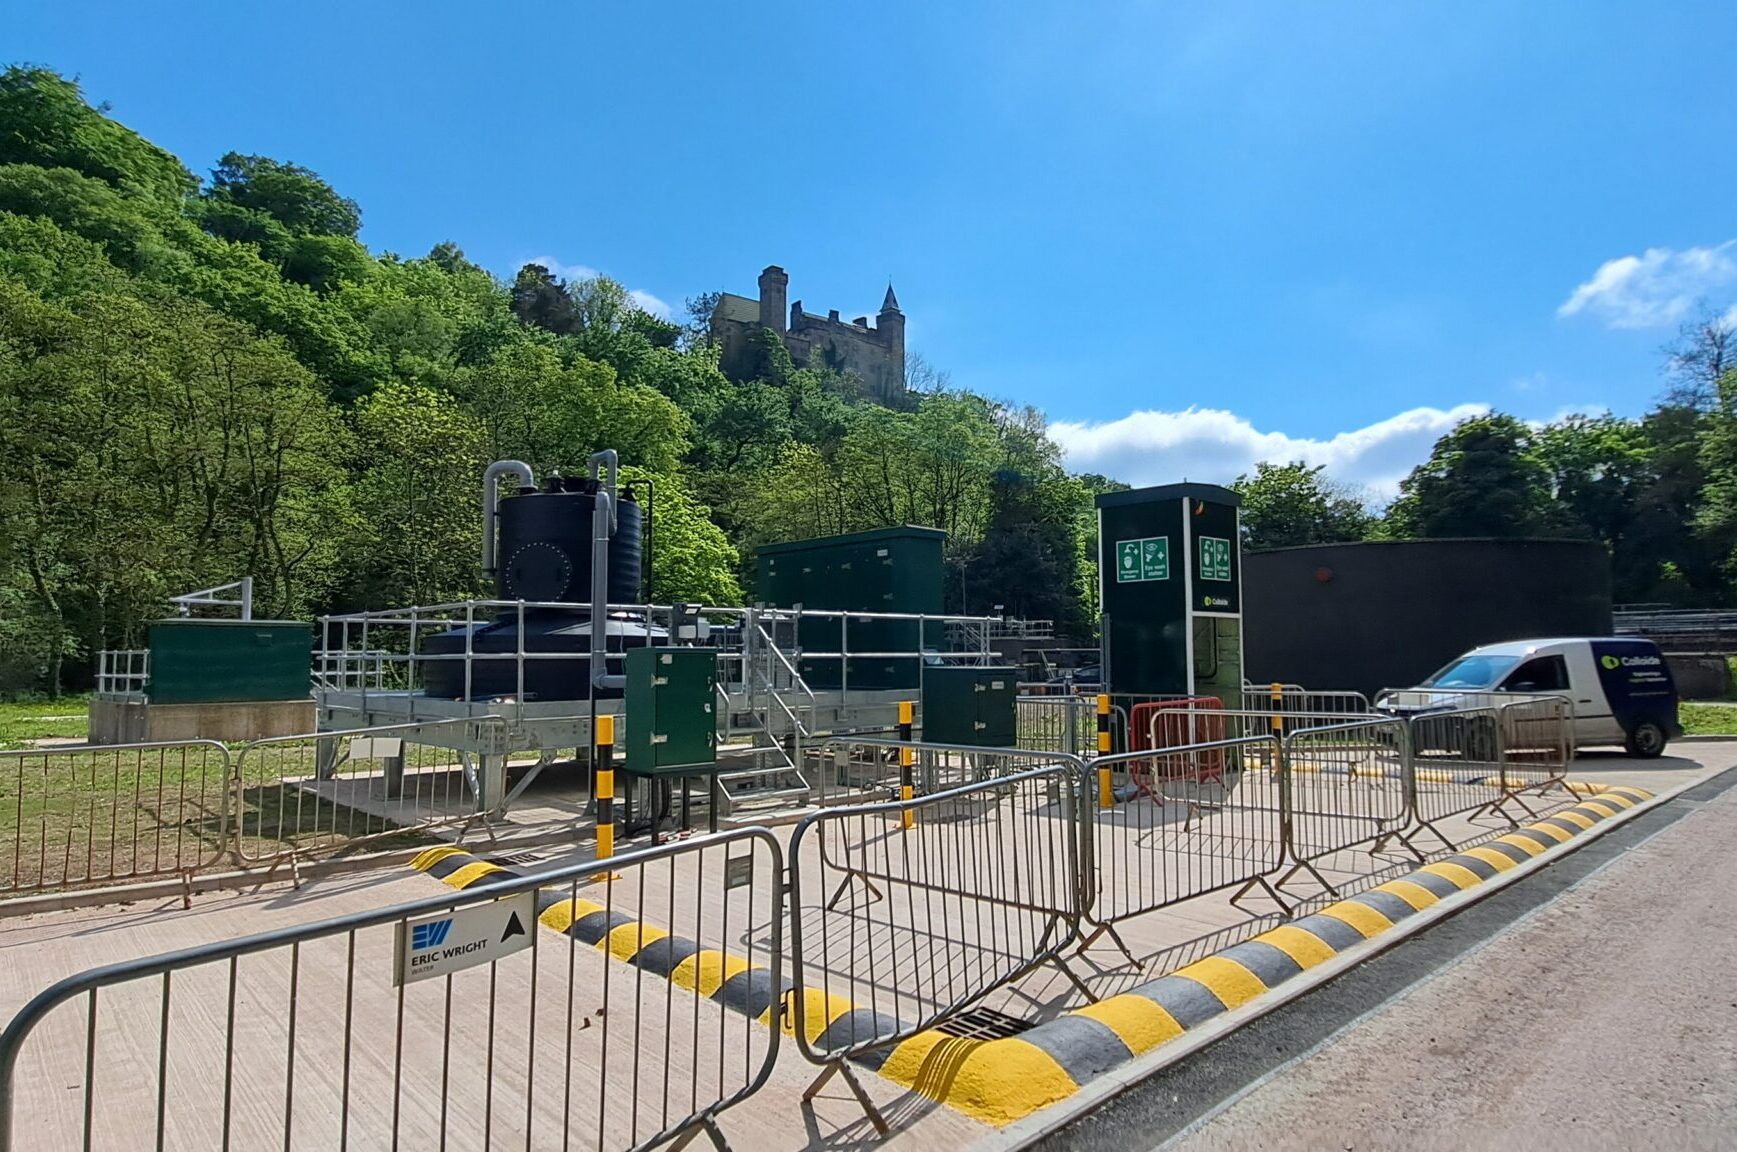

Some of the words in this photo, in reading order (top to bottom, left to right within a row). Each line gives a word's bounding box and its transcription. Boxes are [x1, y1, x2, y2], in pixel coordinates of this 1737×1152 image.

[411, 952, 439, 966] ERIC
[443, 939, 488, 959] WRIGHT
[411, 965, 434, 975] WATER
